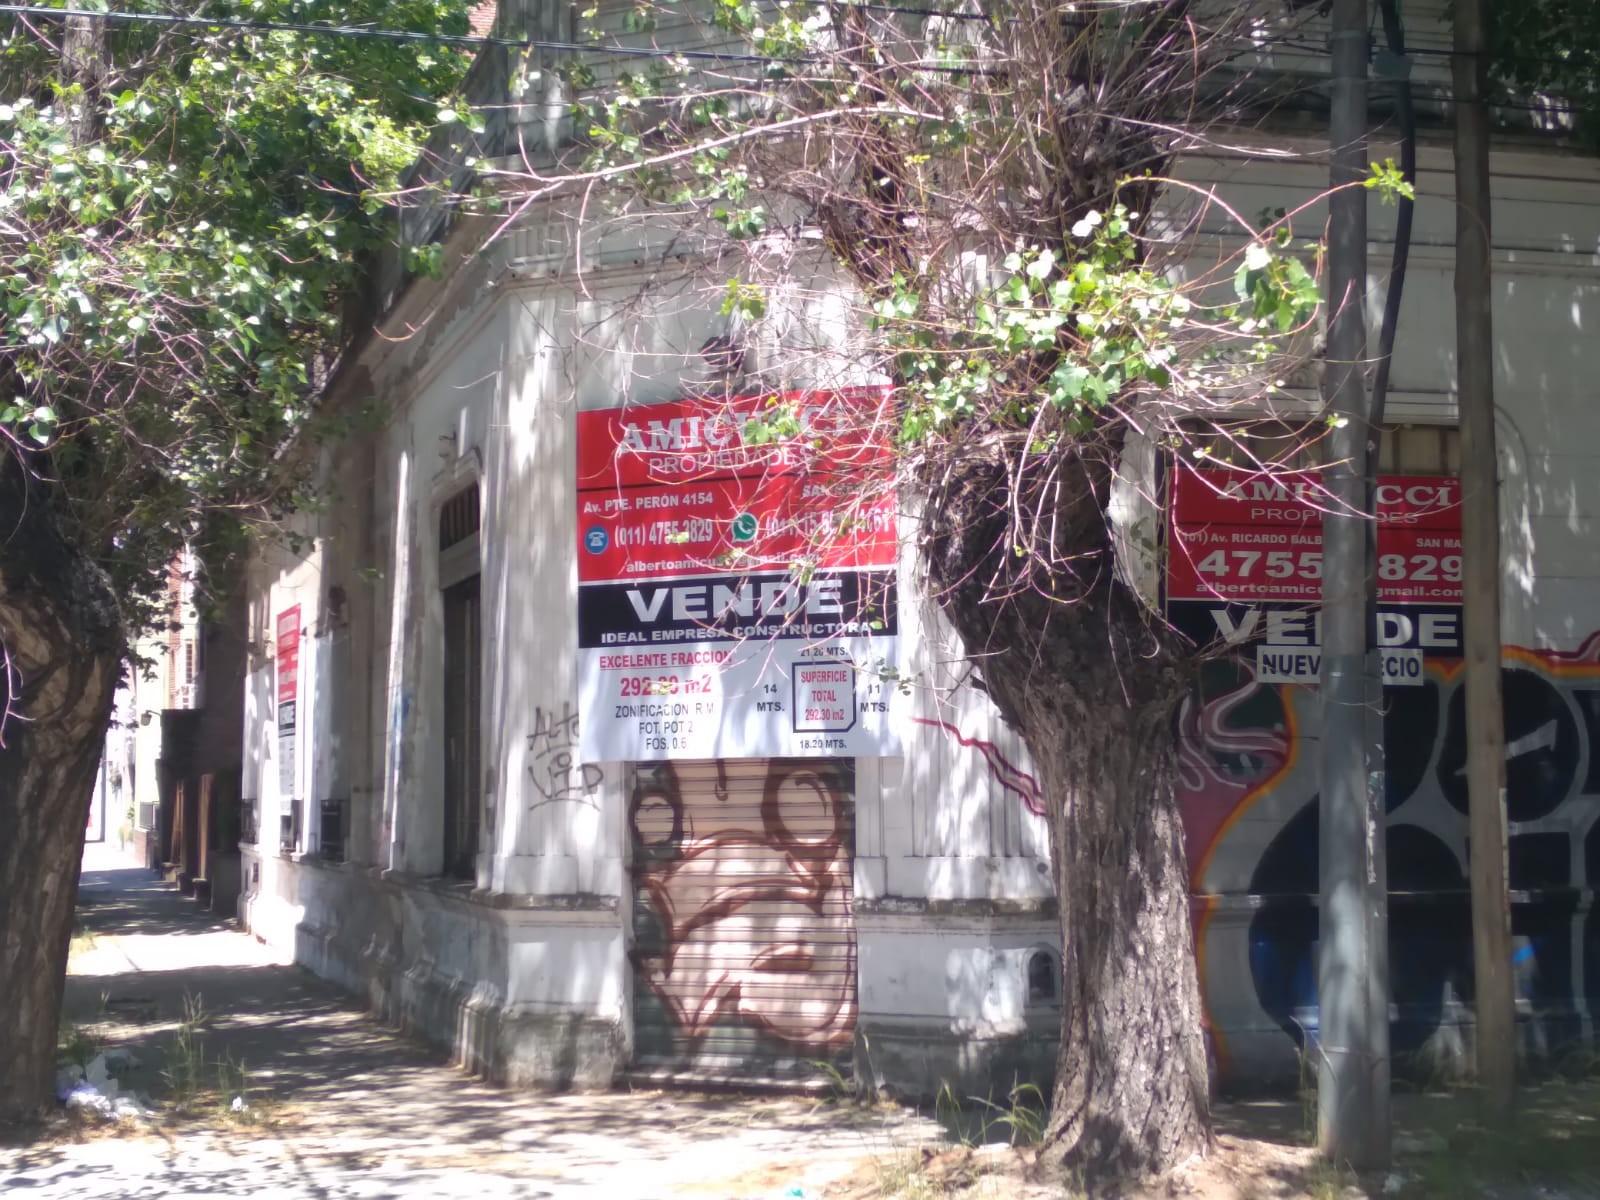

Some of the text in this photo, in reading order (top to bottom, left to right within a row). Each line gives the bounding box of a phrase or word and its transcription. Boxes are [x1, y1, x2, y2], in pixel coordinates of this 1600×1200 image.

[584, 492, 713, 513] Av. PTE. PERÓN 4154
[614, 524, 646, 548] (011)
[1211, 533, 1228, 543] Av.
[1232, 533, 1287, 544] RICARDO
[1416, 537, 1441, 548] SAN
[626, 580, 844, 622] VENDE
[601, 622, 870, 644] IDEAL EMPRESA CONSTRUCTORA
[1209, 609, 1458, 648] VEDE
[827, 646, 848, 655] MTS.
[600, 654, 667, 668] EXCELENTE
[1263, 654, 1322, 675] NUEV
[801, 670, 847, 683] SUPERFICIE
[763, 684, 778, 694] 14
[812, 690, 836, 702] TOTAL
[615, 703, 689, 718] ZONIFICACION
[757, 702, 785, 712] MTS.
[833, 708, 844, 720] m2
[860, 702, 889, 712] MTS.
[639, 721, 661, 735] FOT.
[646, 737, 669, 750] FOS.
[825, 738, 847, 749] MTS.
